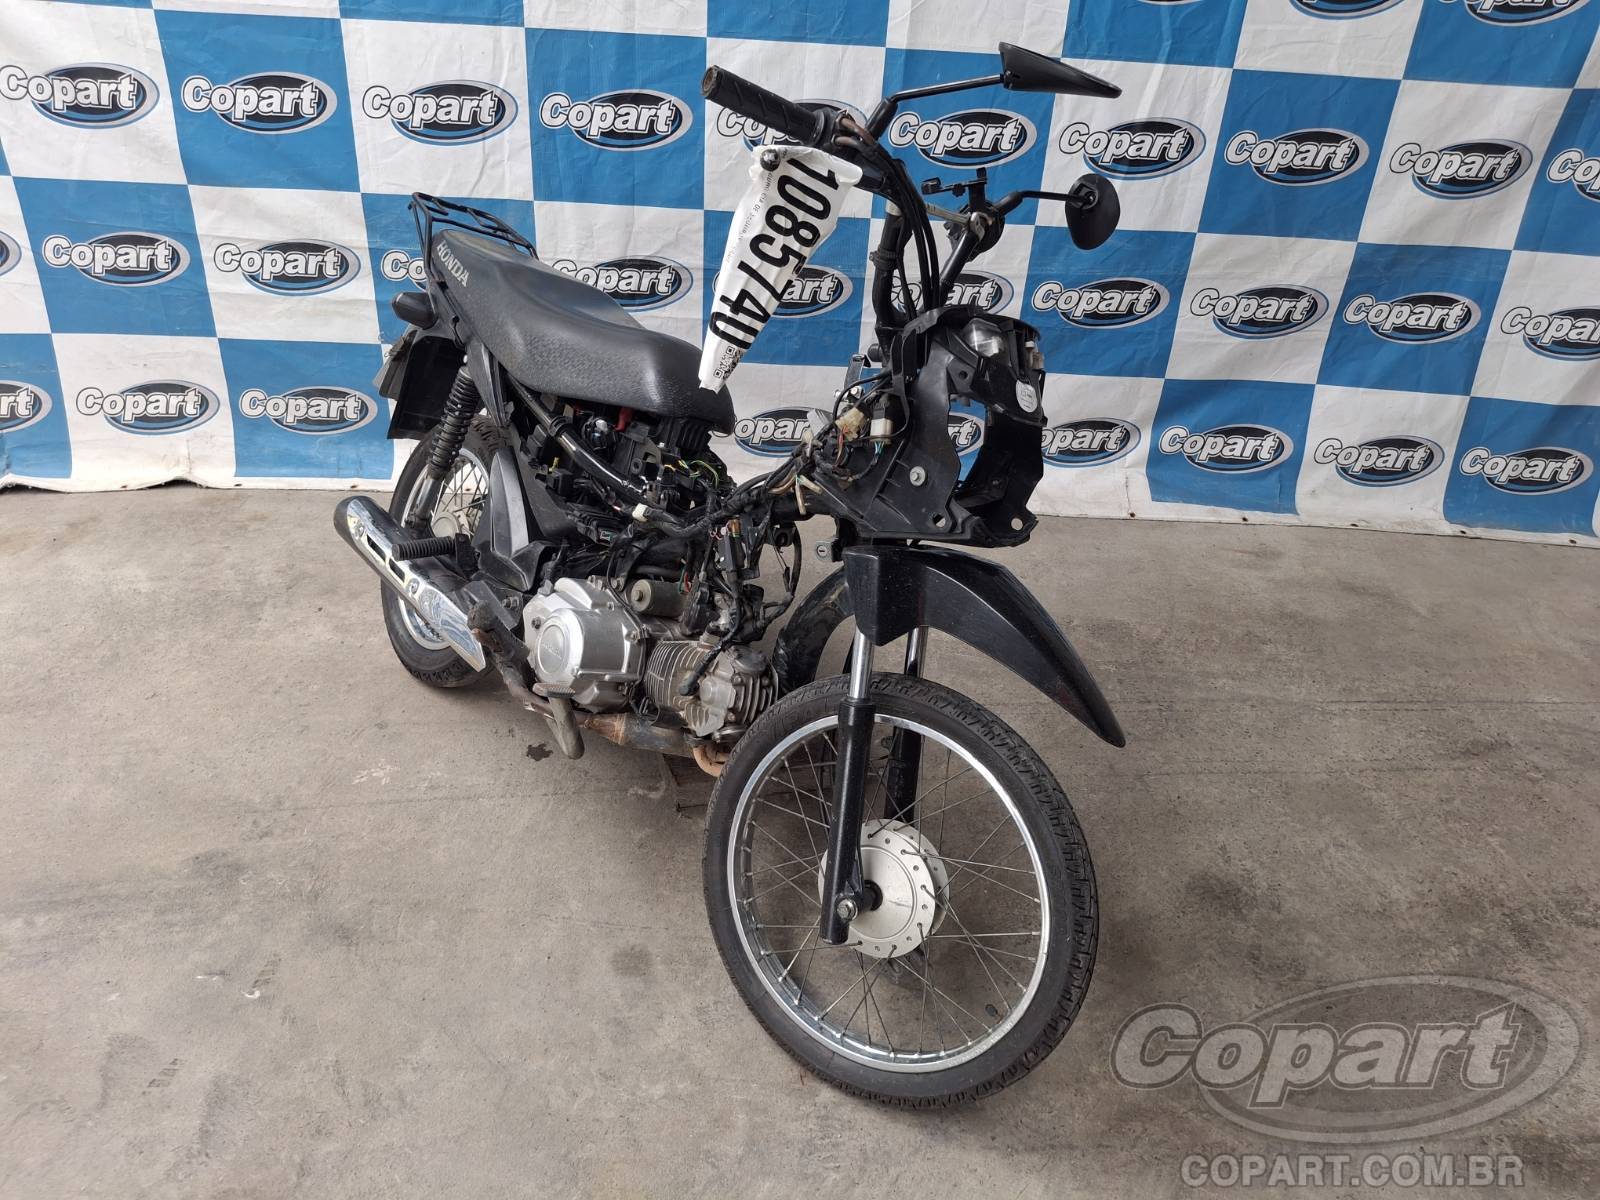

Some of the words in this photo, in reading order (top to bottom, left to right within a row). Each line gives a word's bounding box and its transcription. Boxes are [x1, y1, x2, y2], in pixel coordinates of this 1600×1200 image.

[0, 65, 137, 110] Copart
[181, 75, 321, 120] Copart
[362, 85, 500, 129] Copart
[539, 92, 679, 137] Copart
[888, 109, 1021, 157] Copart
[1058, 121, 1192, 163] Copart
[1224, 131, 1357, 171] Copart
[1389, 142, 1520, 182] Copart
[43, 235, 174, 276] Copart
[213, 243, 344, 280] Copart
[436, 239, 470, 287] HONDA
[710, 157, 839, 350] 1085740
[1032, 281, 1156, 319] Copart
[1189, 287, 1316, 326] Copart
[1343, 295, 1468, 334] Copart
[1500, 306, 1600, 346] Copa
[75, 386, 202, 425] Copart
[240, 388, 362, 423] Copart
[1041, 425, 1126, 456] opart
[1159, 425, 1282, 463] Copart
[1313, 437, 1433, 475] Copart
[1459, 446, 1581, 485] Copart
